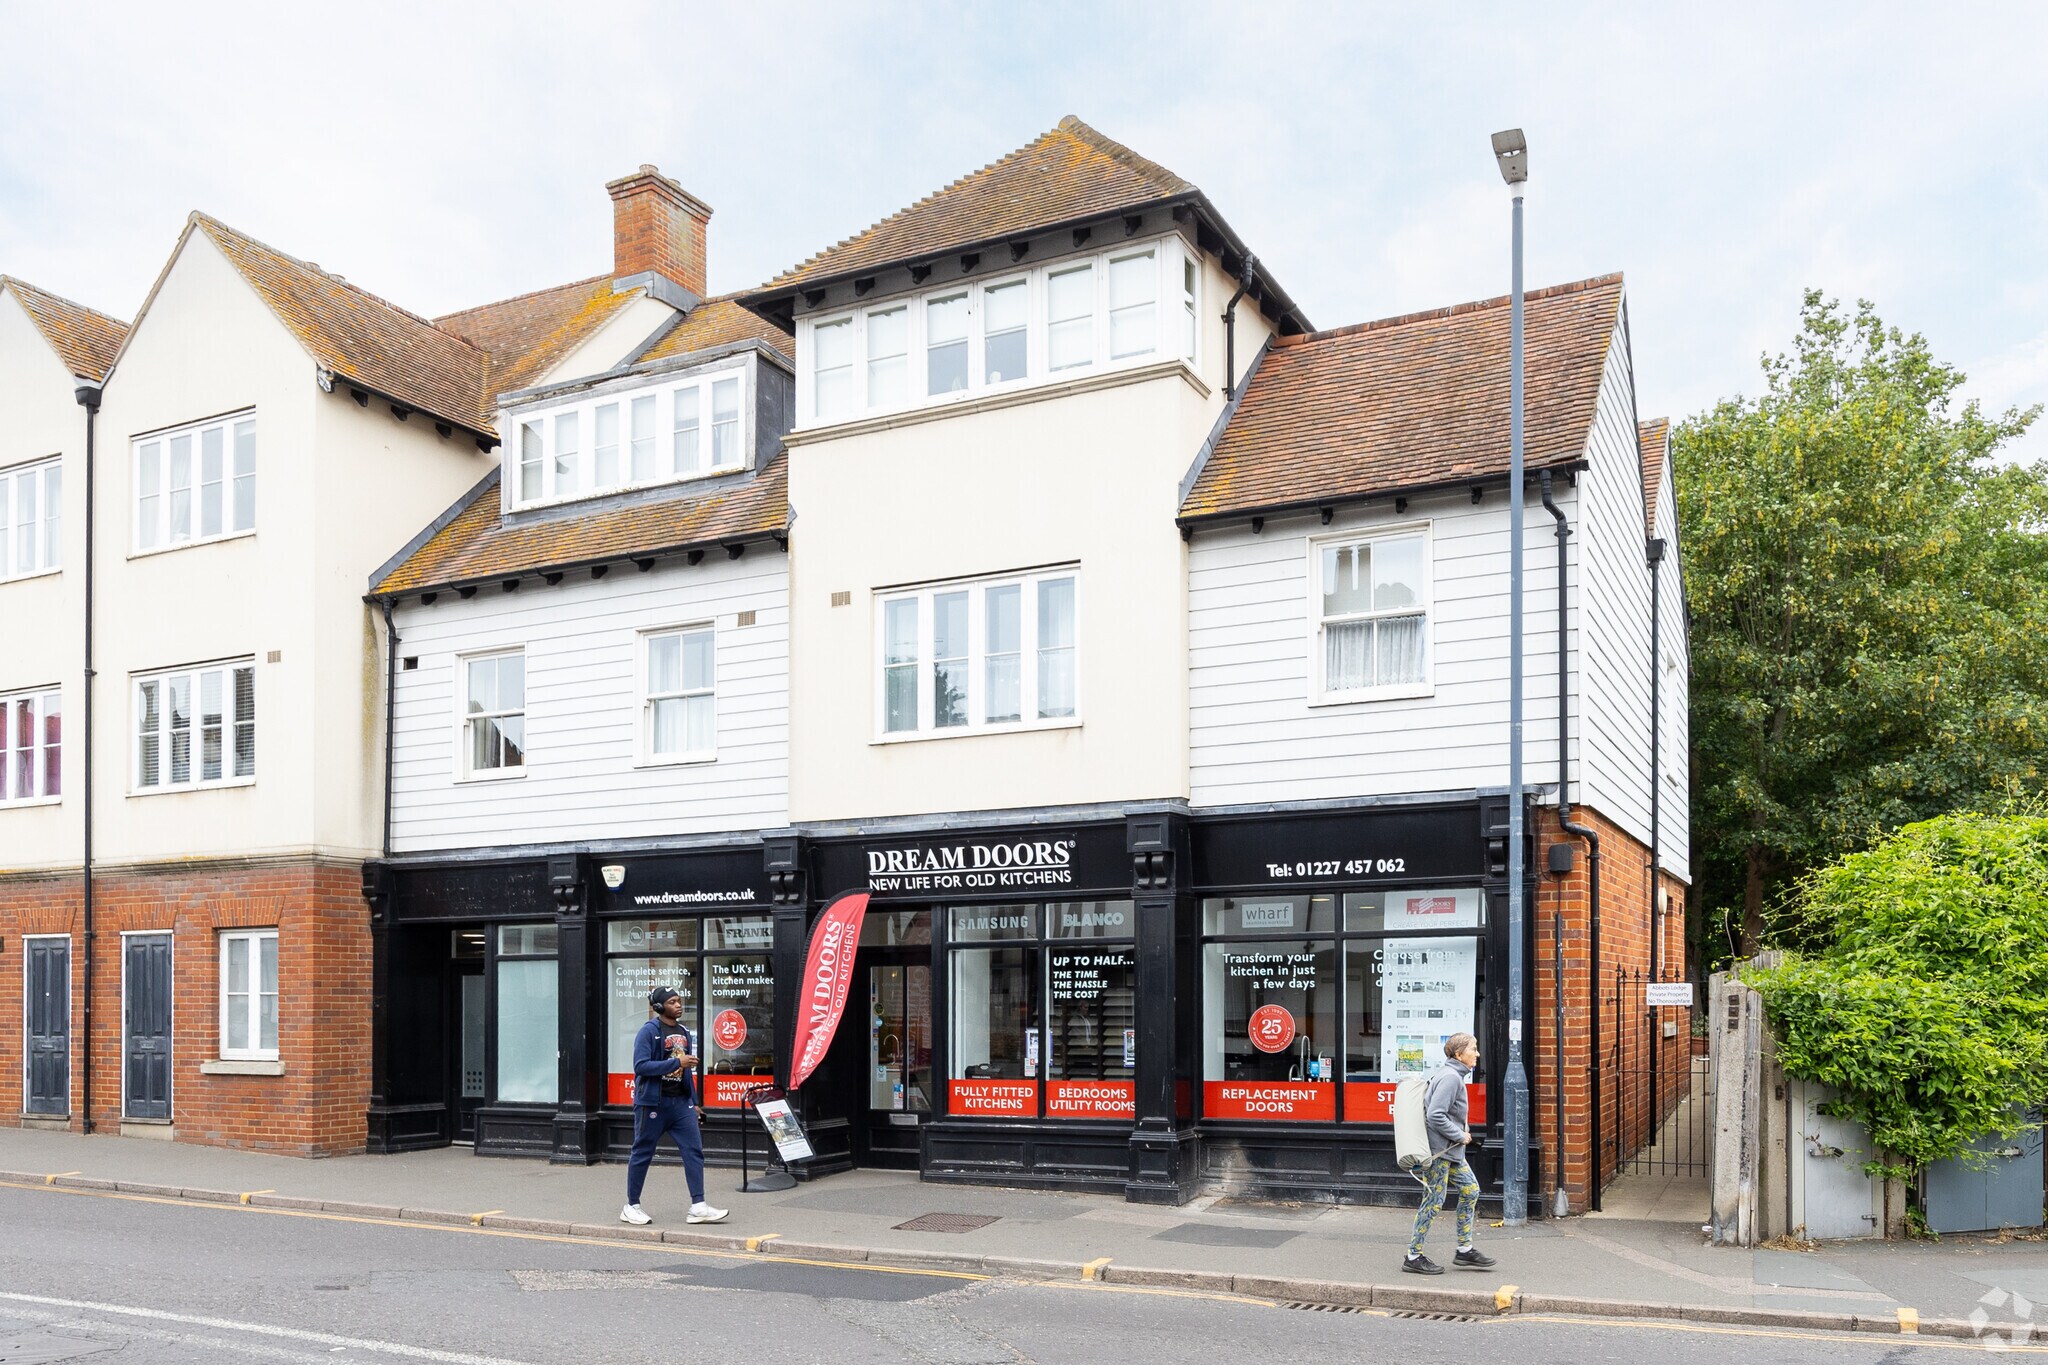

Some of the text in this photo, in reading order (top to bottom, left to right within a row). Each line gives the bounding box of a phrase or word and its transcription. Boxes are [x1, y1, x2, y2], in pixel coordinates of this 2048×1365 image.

[868, 847, 966, 873] DREAM
[1266, 858, 1405, 878] Tel: 01227 457 062
[868, 870, 1072, 891] NEW LIFE FOR OLD KITCHENS
[634, 888, 755, 905] www.dreamdoors.co.uk
[1245, 905, 1289, 920] wharf
[959, 915, 1029, 931] SAMSUNG
[1063, 912, 1125, 927] BLANCO
[725, 928, 773, 939] FRANK
[1222, 952, 1315, 965] Transform your
[1373, 949, 1420, 960] Choose
[1426, 949, 1456, 960] from
[1053, 955, 1134, 967] UP TO HALF...
[615, 966, 691, 977] Complete service,
[712, 964, 729, 974] The
[731, 964, 752, 974] UK's
[1053, 970, 1099, 979] THE TIME
[1230, 965, 1315, 978] kitchen in just
[615, 976, 683, 988] fully installed by
[712, 975, 744, 985] kitchen
[1053, 980, 1108, 989] THE HASSLE
[1253, 978, 1315, 991] a few days
[615, 989, 634, 998] local
[712, 989, 751, 999] company
[813, 923, 856, 1056] LIFE FOR OLD KITCHENS
[1053, 990, 1099, 999] THE COST
[722, 1021, 737, 1035] 25
[1261, 1018, 1282, 1035] 25
[800, 1005, 829, 1071] REAM
[954, 1086, 1034, 1098] FULLY FITTED
[1058, 1088, 1127, 1099] BEDROOMS
[1222, 1088, 1317, 1100] REPLACEMENT
[965, 1098, 1023, 1109] KITCHENS
[1050, 1100, 1136, 1111] UTILITY ROOMS
[1245, 1102, 1293, 1112] DOORS
